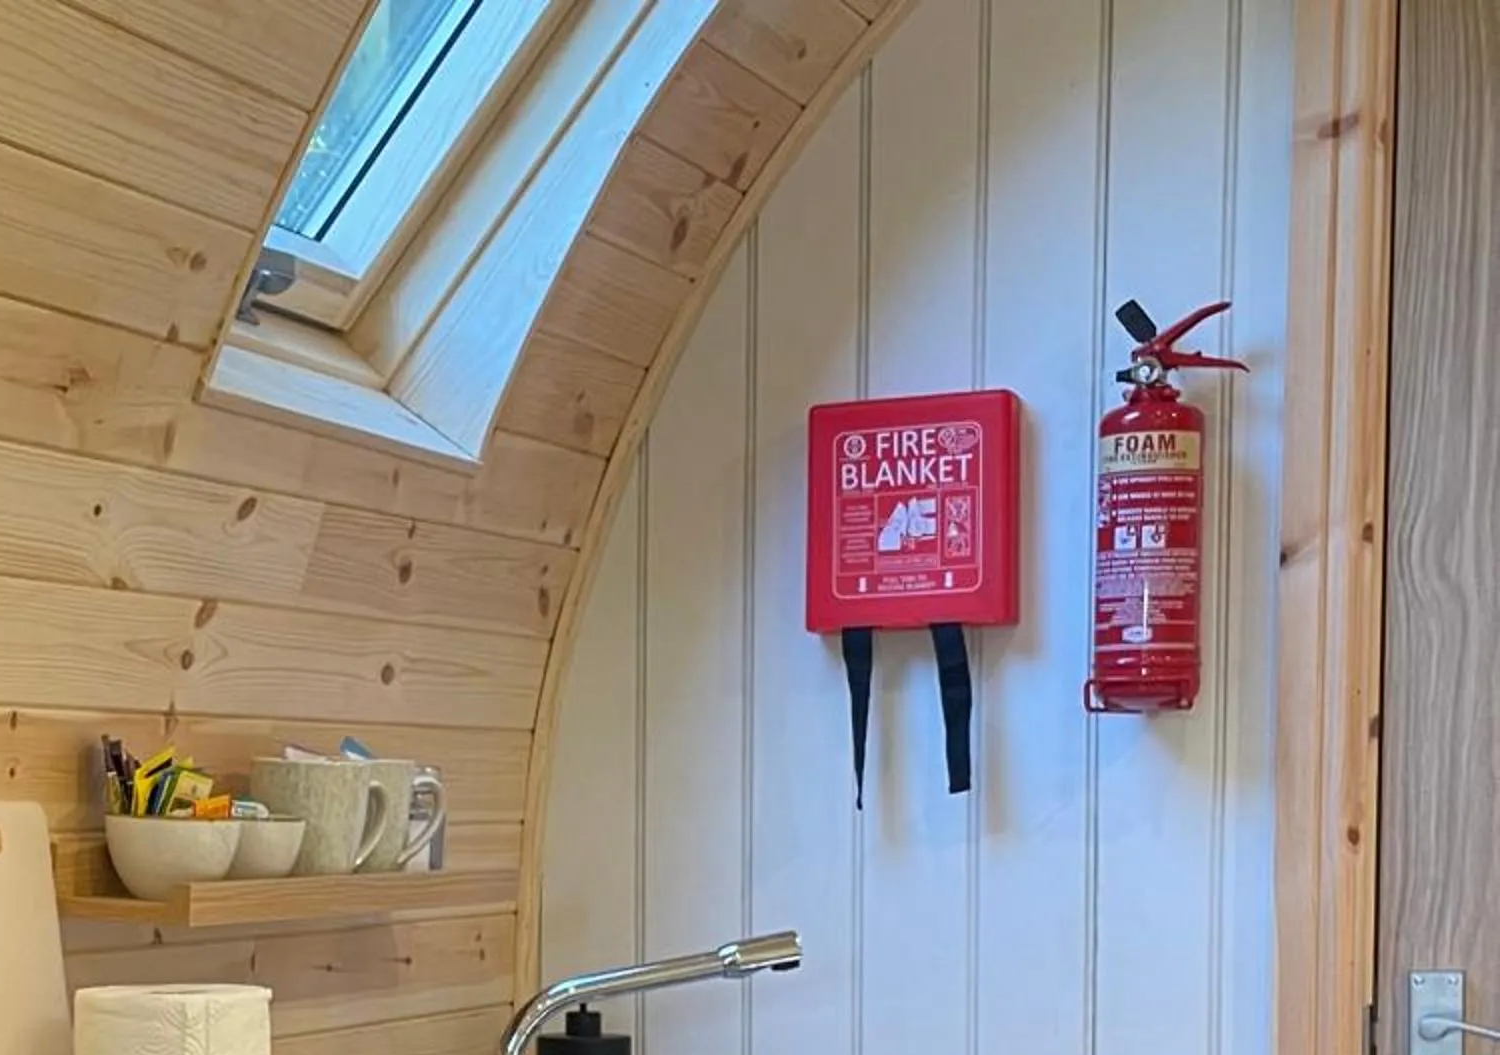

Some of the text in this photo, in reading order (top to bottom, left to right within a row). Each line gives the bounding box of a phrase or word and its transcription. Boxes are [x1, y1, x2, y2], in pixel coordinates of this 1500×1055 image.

[875, 429, 937, 459] FIRE
[1114, 434, 1176, 453] FOAM
[840, 454, 973, 490] BLANKET
